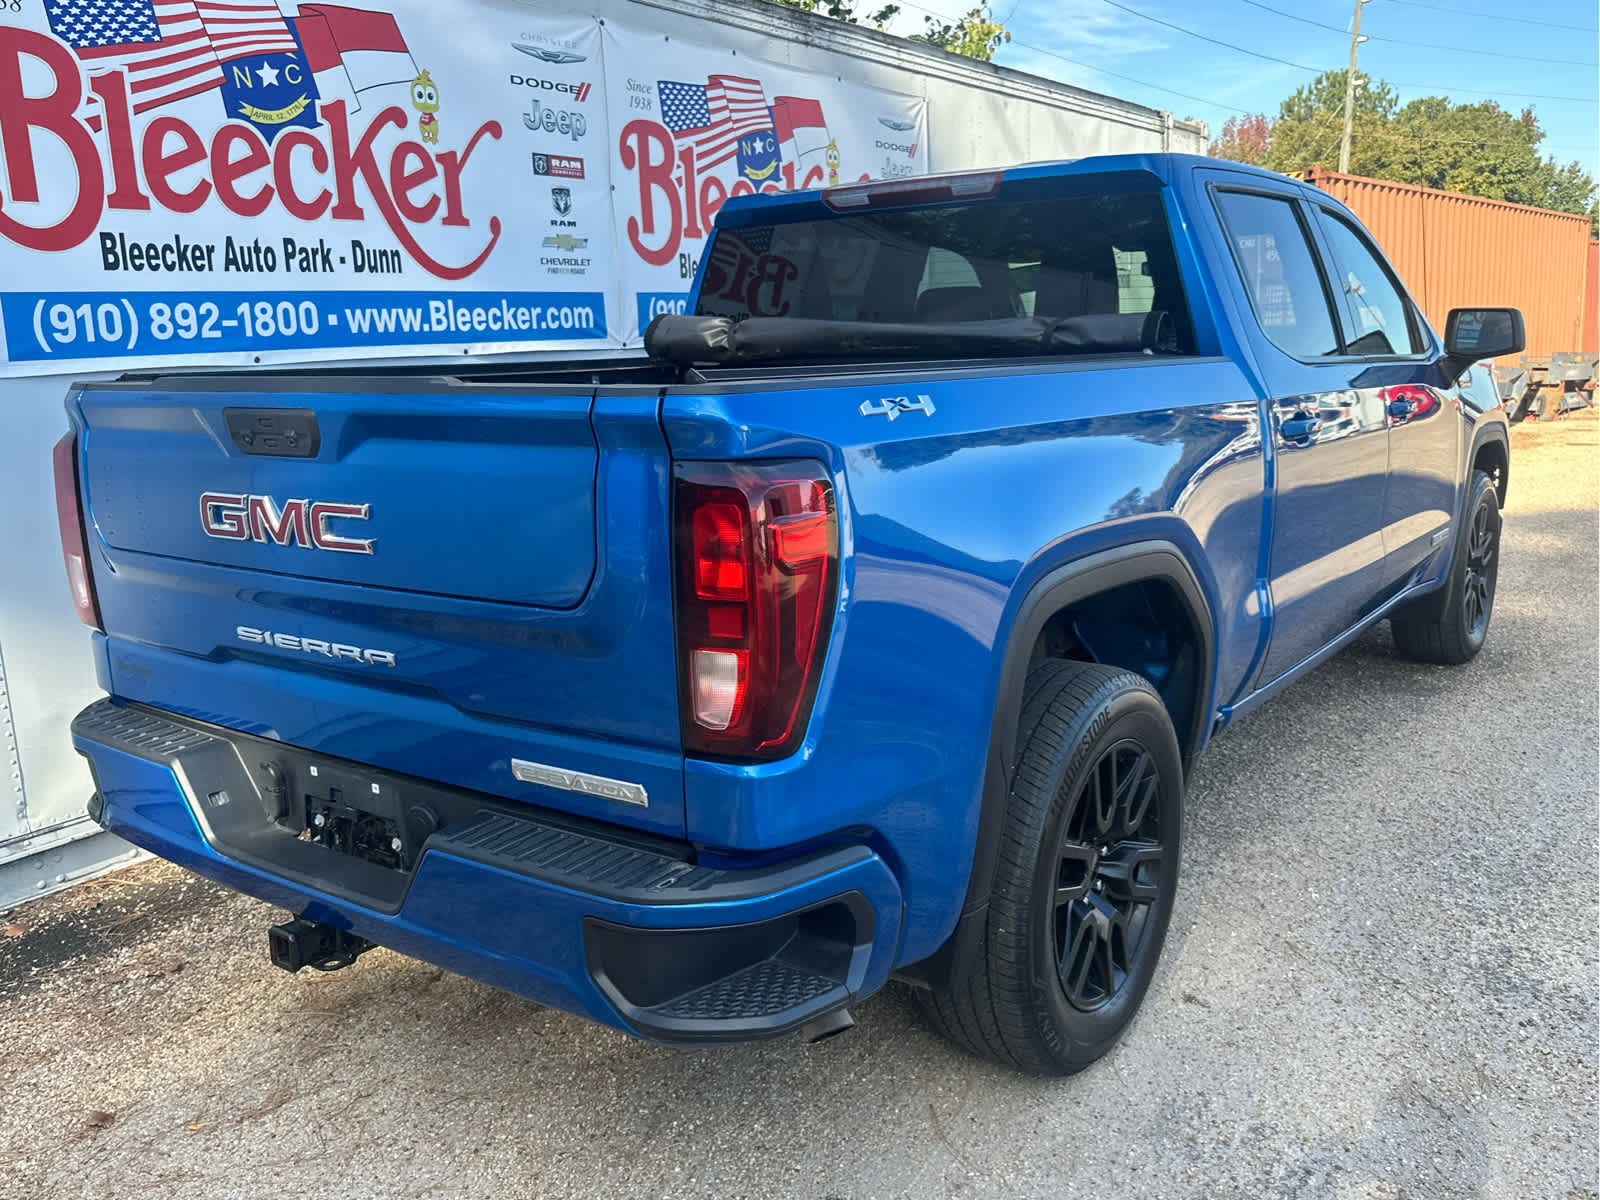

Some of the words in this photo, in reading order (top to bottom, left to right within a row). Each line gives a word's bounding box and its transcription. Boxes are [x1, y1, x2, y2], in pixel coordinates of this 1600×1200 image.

[232, 65, 253, 89] N
[284, 63, 302, 84] C
[510, 74, 581, 95] DODGE
[626, 78, 653, 95] Since
[629, 95, 652, 111] 1938
[522, 99, 587, 141] Jeep
[0, 25, 503, 281] Bleecker
[742, 140, 752, 156] N
[766, 137, 776, 152] C
[875, 140, 912, 153] DODGE
[551, 159, 581, 169] RAM
[550, 219, 577, 228] RAM
[100, 231, 215, 273] Bleecker
[224, 236, 277, 273] Auto
[284, 238, 335, 274] Park
[352, 239, 403, 274] Dunn
[540, 257, 591, 267] CHEVROLET
[33, 299, 138, 352] (910)
[149, 301, 320, 341] 892-1800
[345, 299, 594, 335] www.Bleecker.com
[199, 490, 378, 556] GMC
[236, 625, 397, 668] SIERRA
